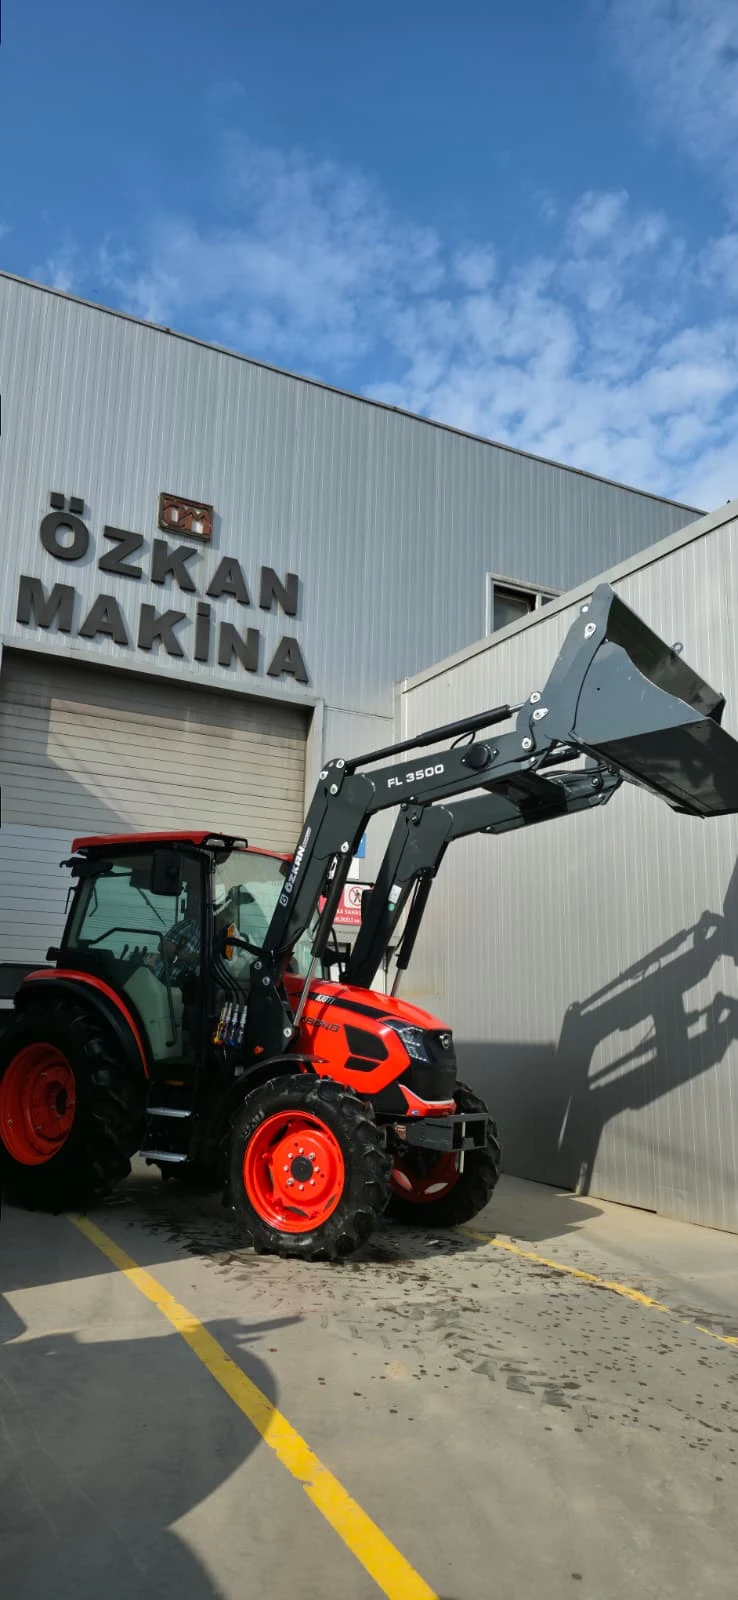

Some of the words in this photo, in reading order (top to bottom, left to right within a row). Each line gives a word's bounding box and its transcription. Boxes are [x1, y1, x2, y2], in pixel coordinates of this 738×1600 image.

[40, 492, 298, 616] ÖZKAN
[17, 575, 309, 683] MAKİNA
[387, 776, 403, 788] FL
[405, 764, 445, 783] 3500
